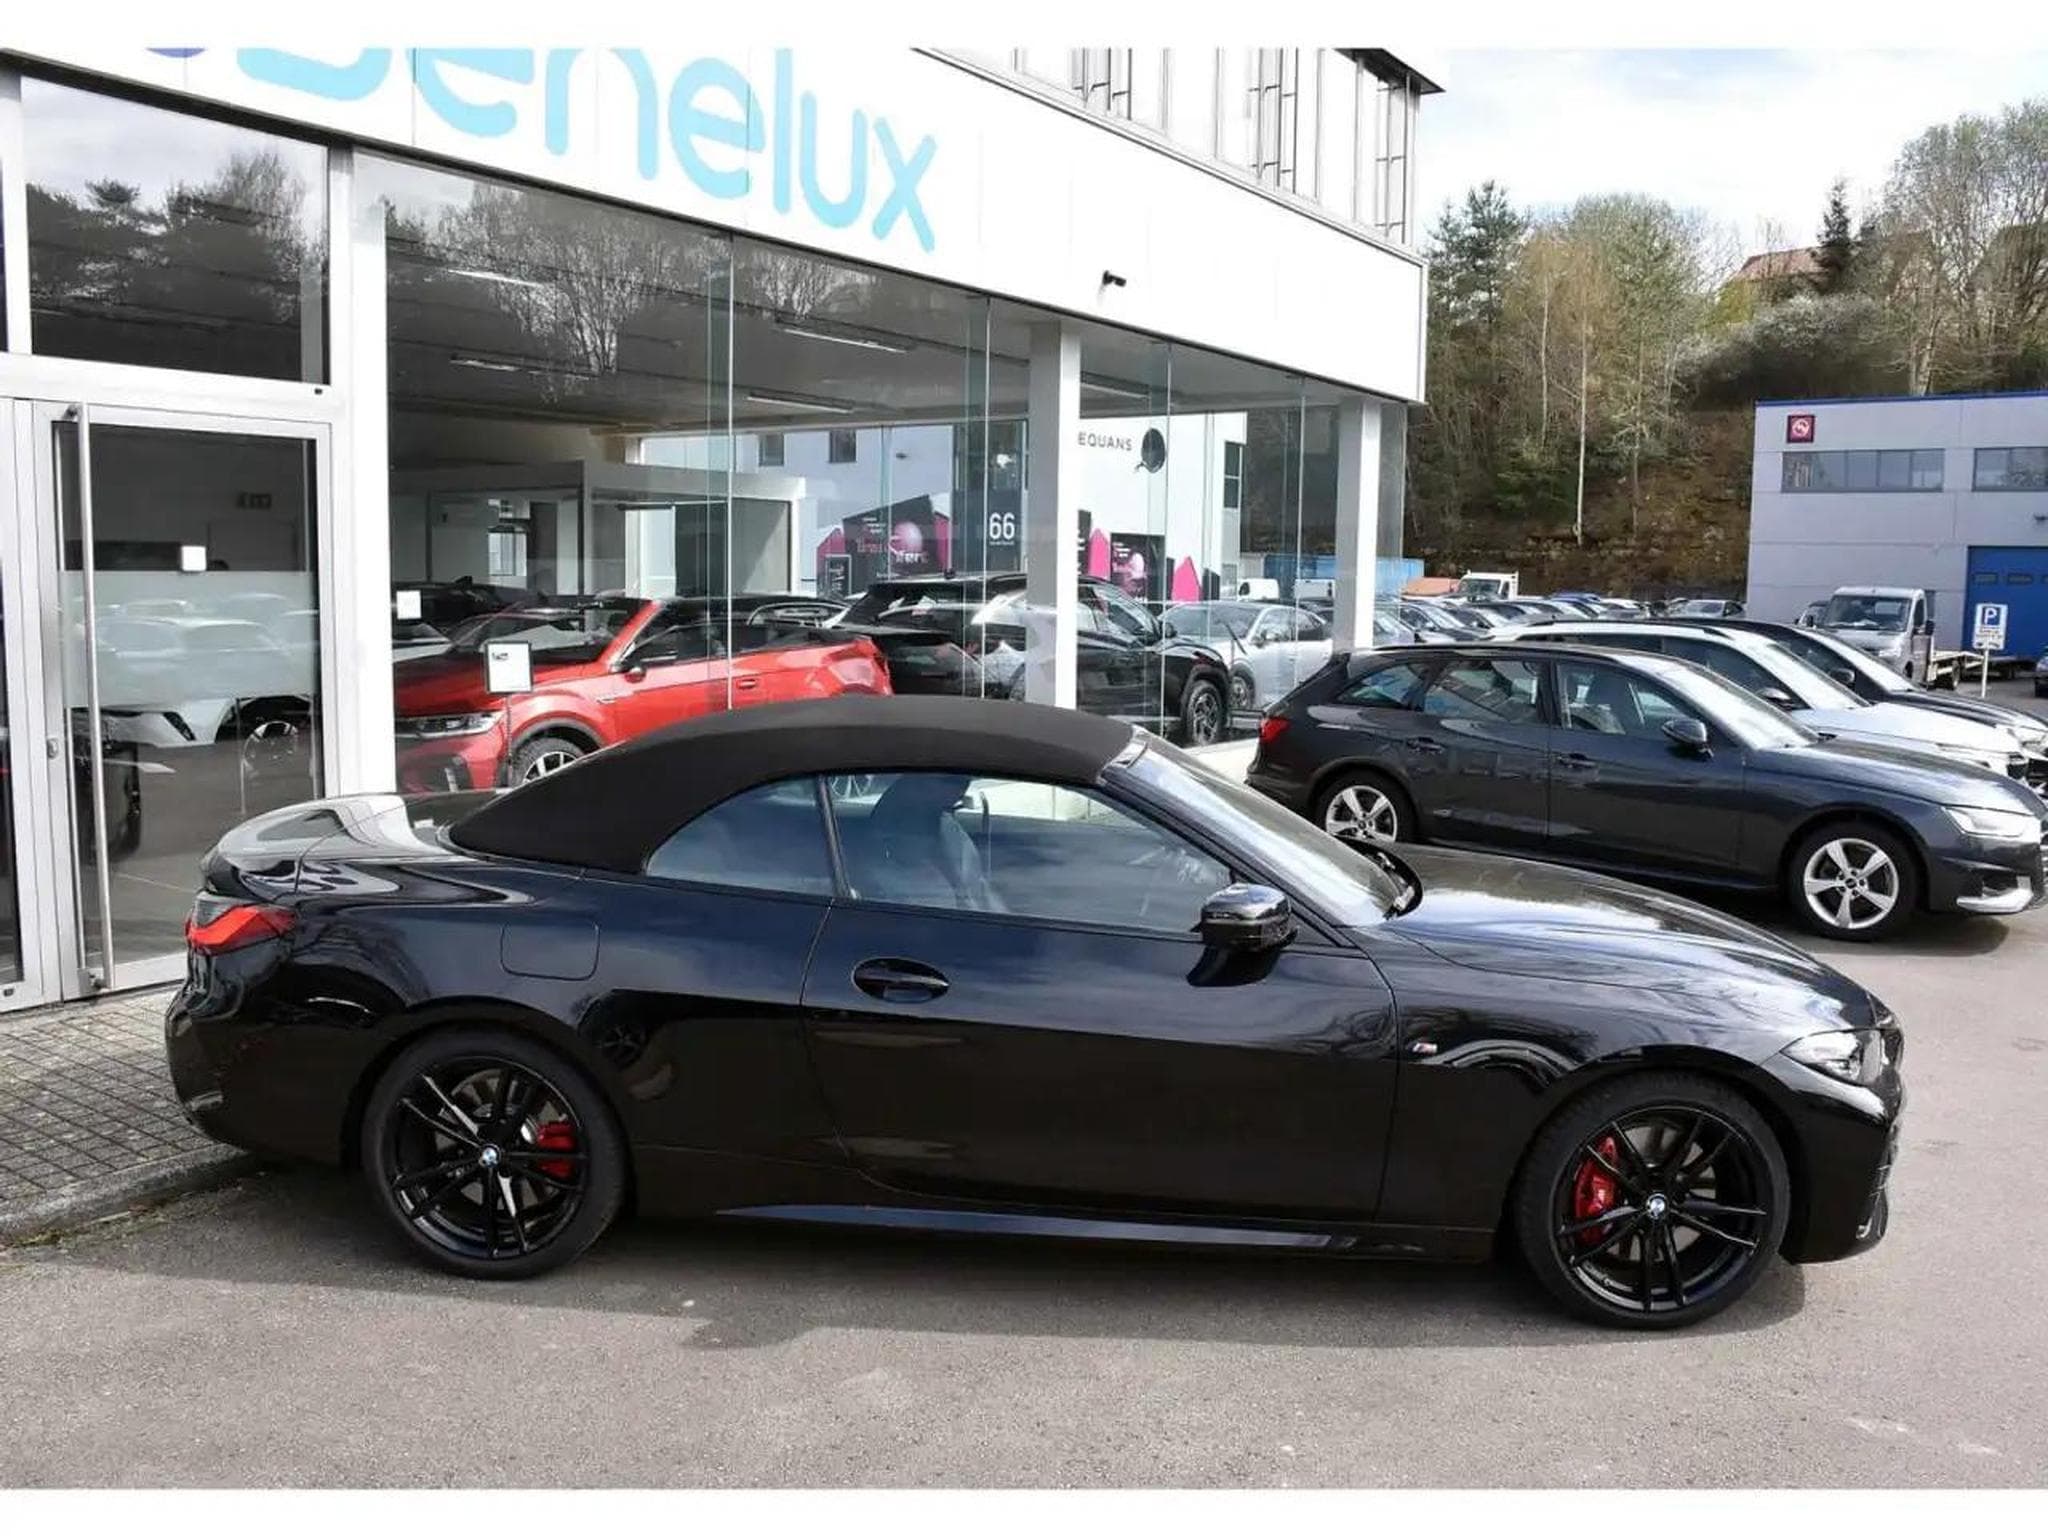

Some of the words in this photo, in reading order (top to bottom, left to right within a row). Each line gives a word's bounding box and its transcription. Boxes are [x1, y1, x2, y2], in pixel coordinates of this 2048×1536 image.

[1078, 432, 1132, 451] EQUANS
[989, 512, 1015, 540] 66
[1984, 607, 1997, 625] P
